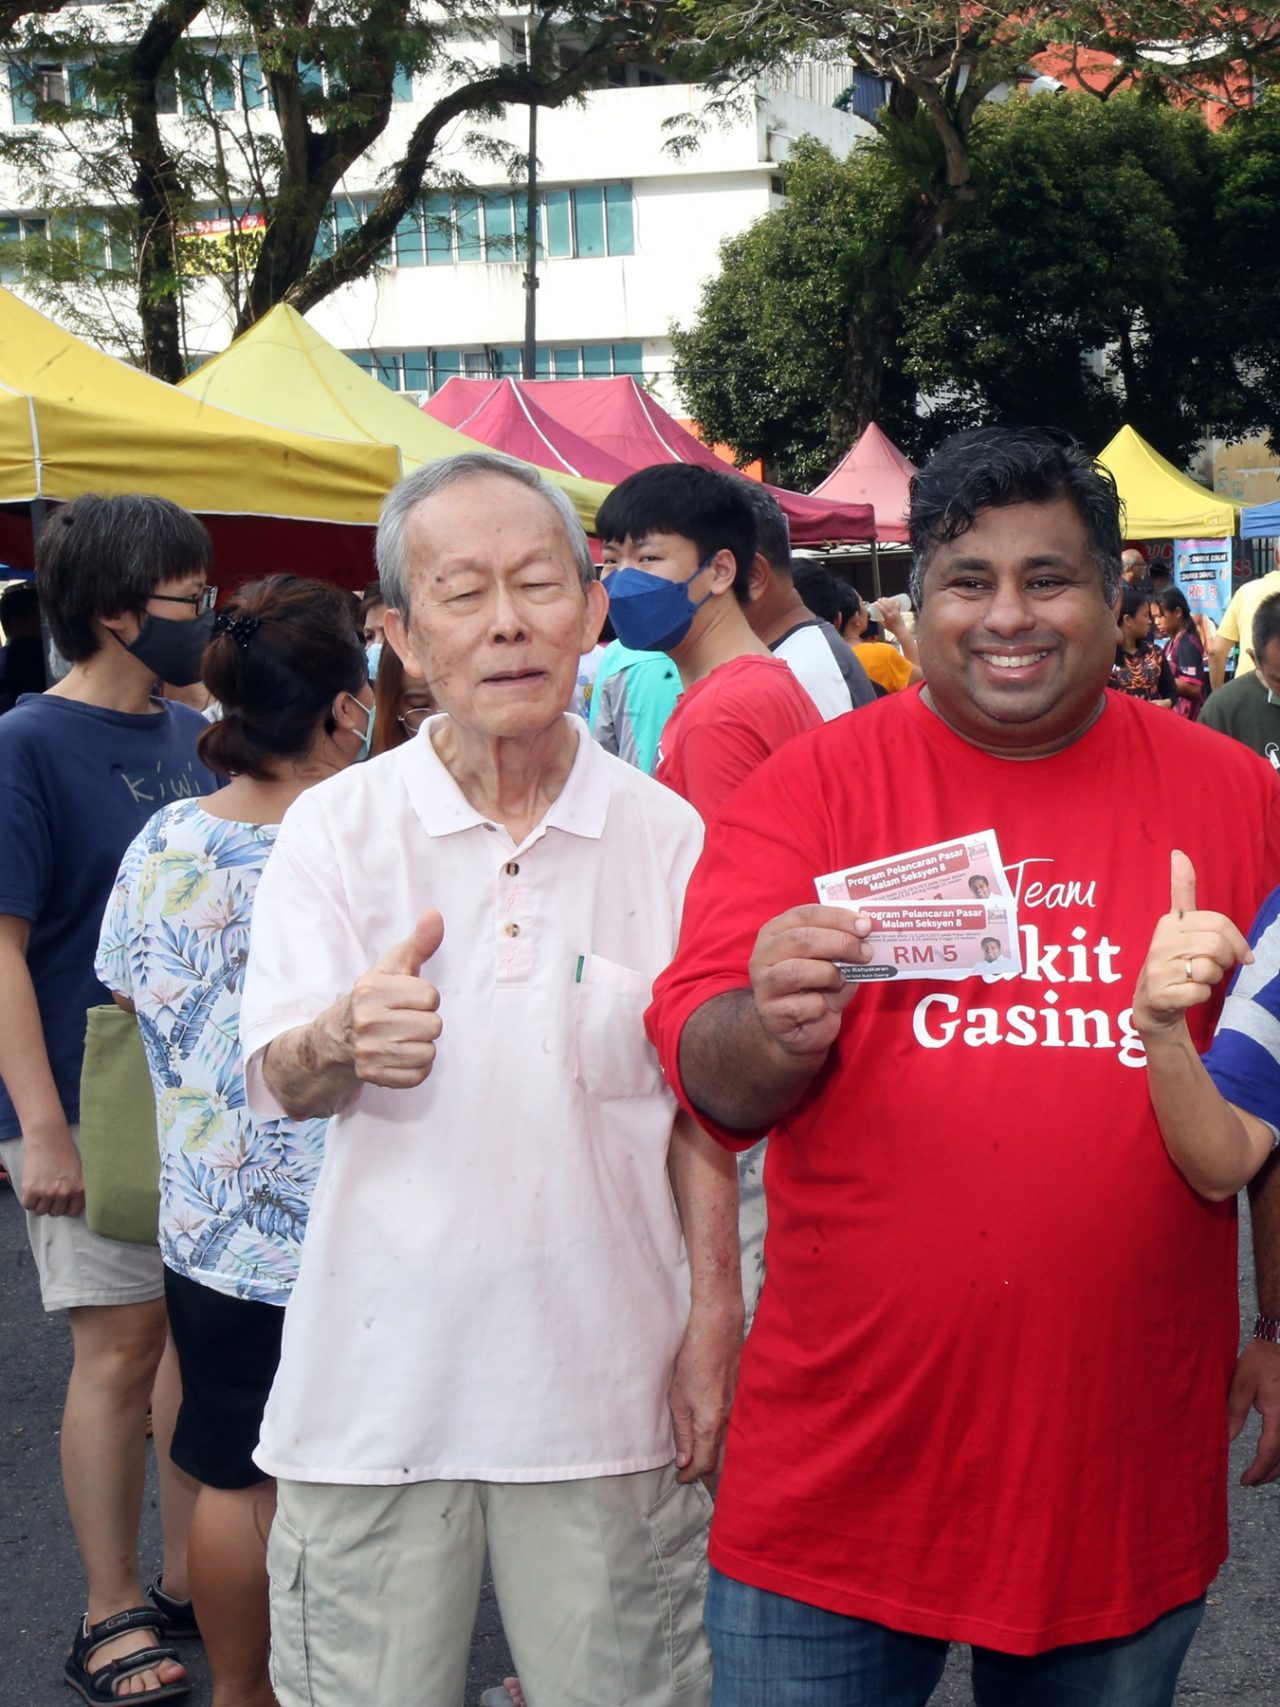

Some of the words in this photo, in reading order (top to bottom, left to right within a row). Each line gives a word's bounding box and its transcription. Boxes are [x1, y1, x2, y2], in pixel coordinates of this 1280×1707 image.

[847, 871, 886, 887] Program
[886, 856, 937, 877] Pelancaran
[938, 848, 964, 862] Pasar
[869, 877, 900, 891] Malam
[901, 867, 939, 883] Seksyen
[939, 864, 946, 872] 8
[1002, 858, 1097, 911] Team
[882, 920, 913, 928] Malam
[915, 919, 953, 929] Seksyen
[955, 919, 962, 927] 8
[902, 909, 954, 918] Pelancaran
[956, 909, 983, 918] Pasar
[893, 945, 934, 964] RM
[943, 945, 958, 962] 5
[912, 988, 1148, 1068] Gasing
